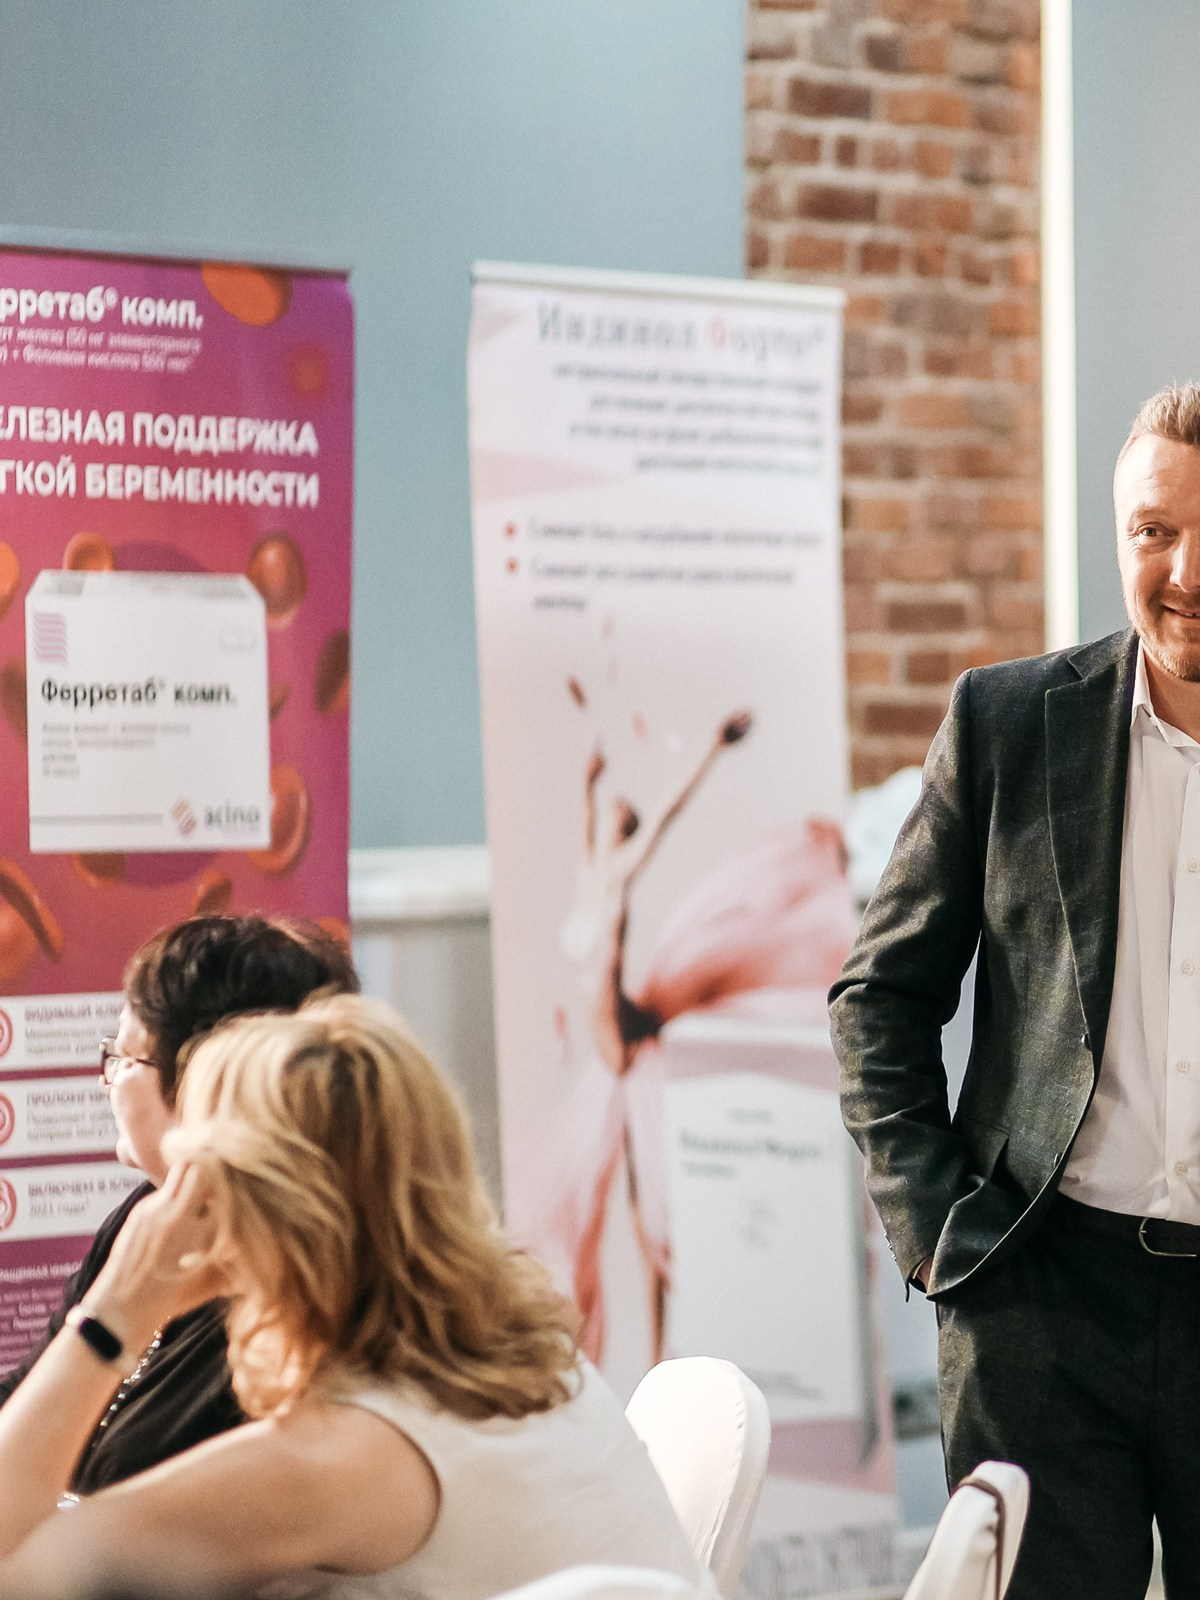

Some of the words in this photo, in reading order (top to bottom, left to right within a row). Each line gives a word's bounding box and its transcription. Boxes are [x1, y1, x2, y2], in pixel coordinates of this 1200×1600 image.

[0, 286, 119, 324] рретаб®
[122, 296, 204, 330] комп.
[0, 405, 125, 447] ЛЕЗНАЯ
[133, 412, 319, 457] ПОДДЕРЖКА
[85, 462, 320, 508] БЕРЕМЕННОСТИ
